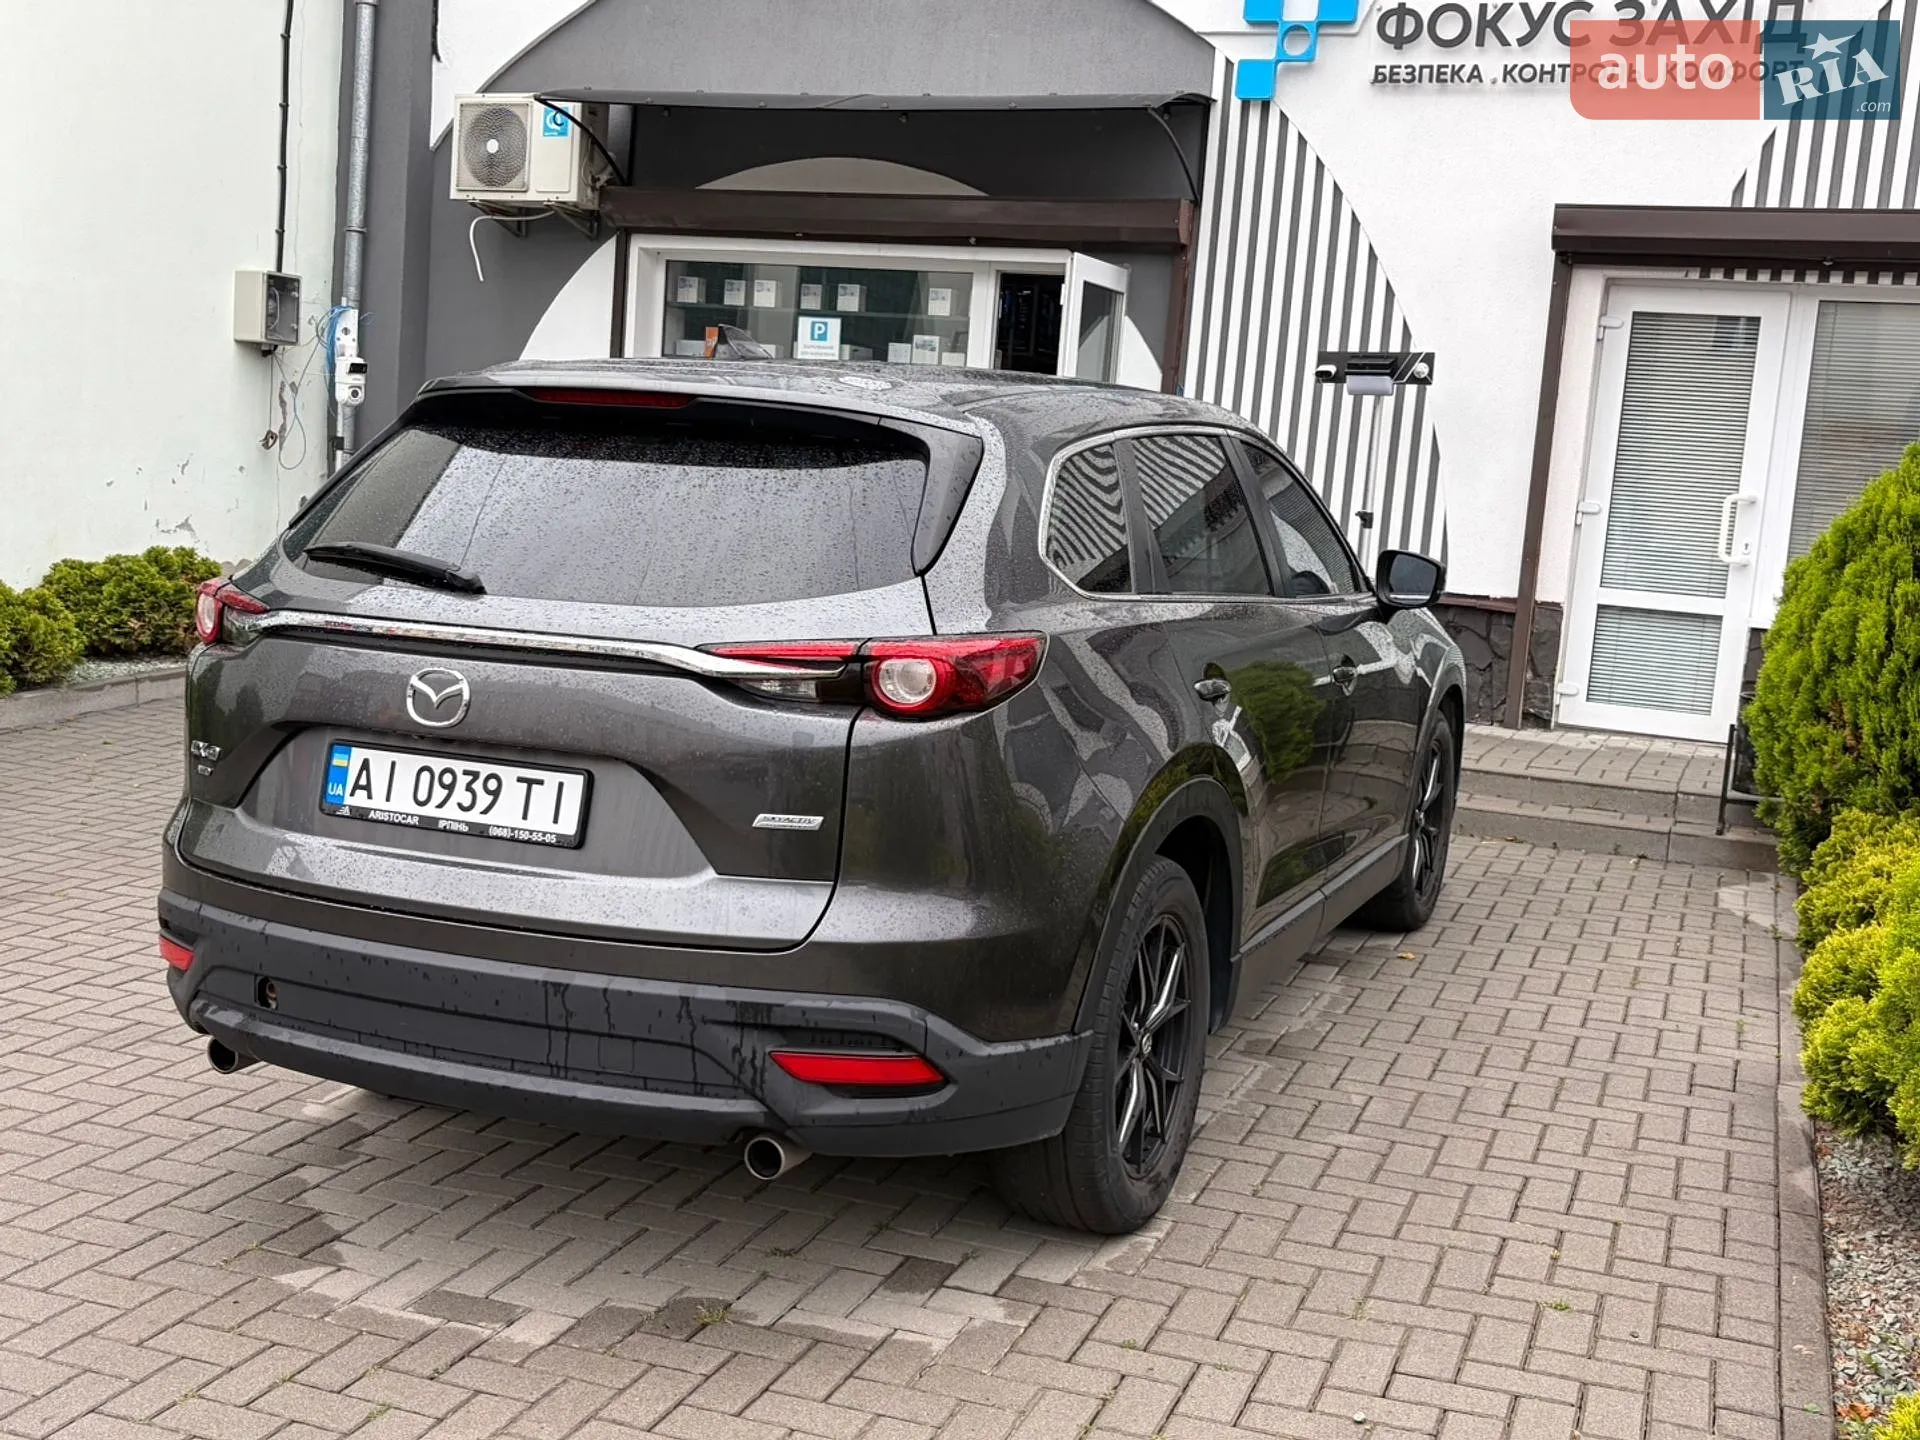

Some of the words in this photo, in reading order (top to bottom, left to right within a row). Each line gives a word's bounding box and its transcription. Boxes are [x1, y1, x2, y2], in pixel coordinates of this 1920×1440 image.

[1376, 2, 1594, 50] ФОКУС
[1608, 0, 1808, 55] ЗАХІД
[1373, 64, 1484, 84] БЕЗПЕКА
[1502, 62, 1641, 84] КОНТРОЬ
[328, 783, 344, 797] UA
[349, 757, 397, 803] AI
[412, 765, 504, 816] 0939
[516, 775, 565, 825] TI
[368, 810, 419, 826] ARISTOCAR
[438, 818, 469, 832] ІРПІНЬ
[488, 824, 557, 845] (068)-150-55-05
